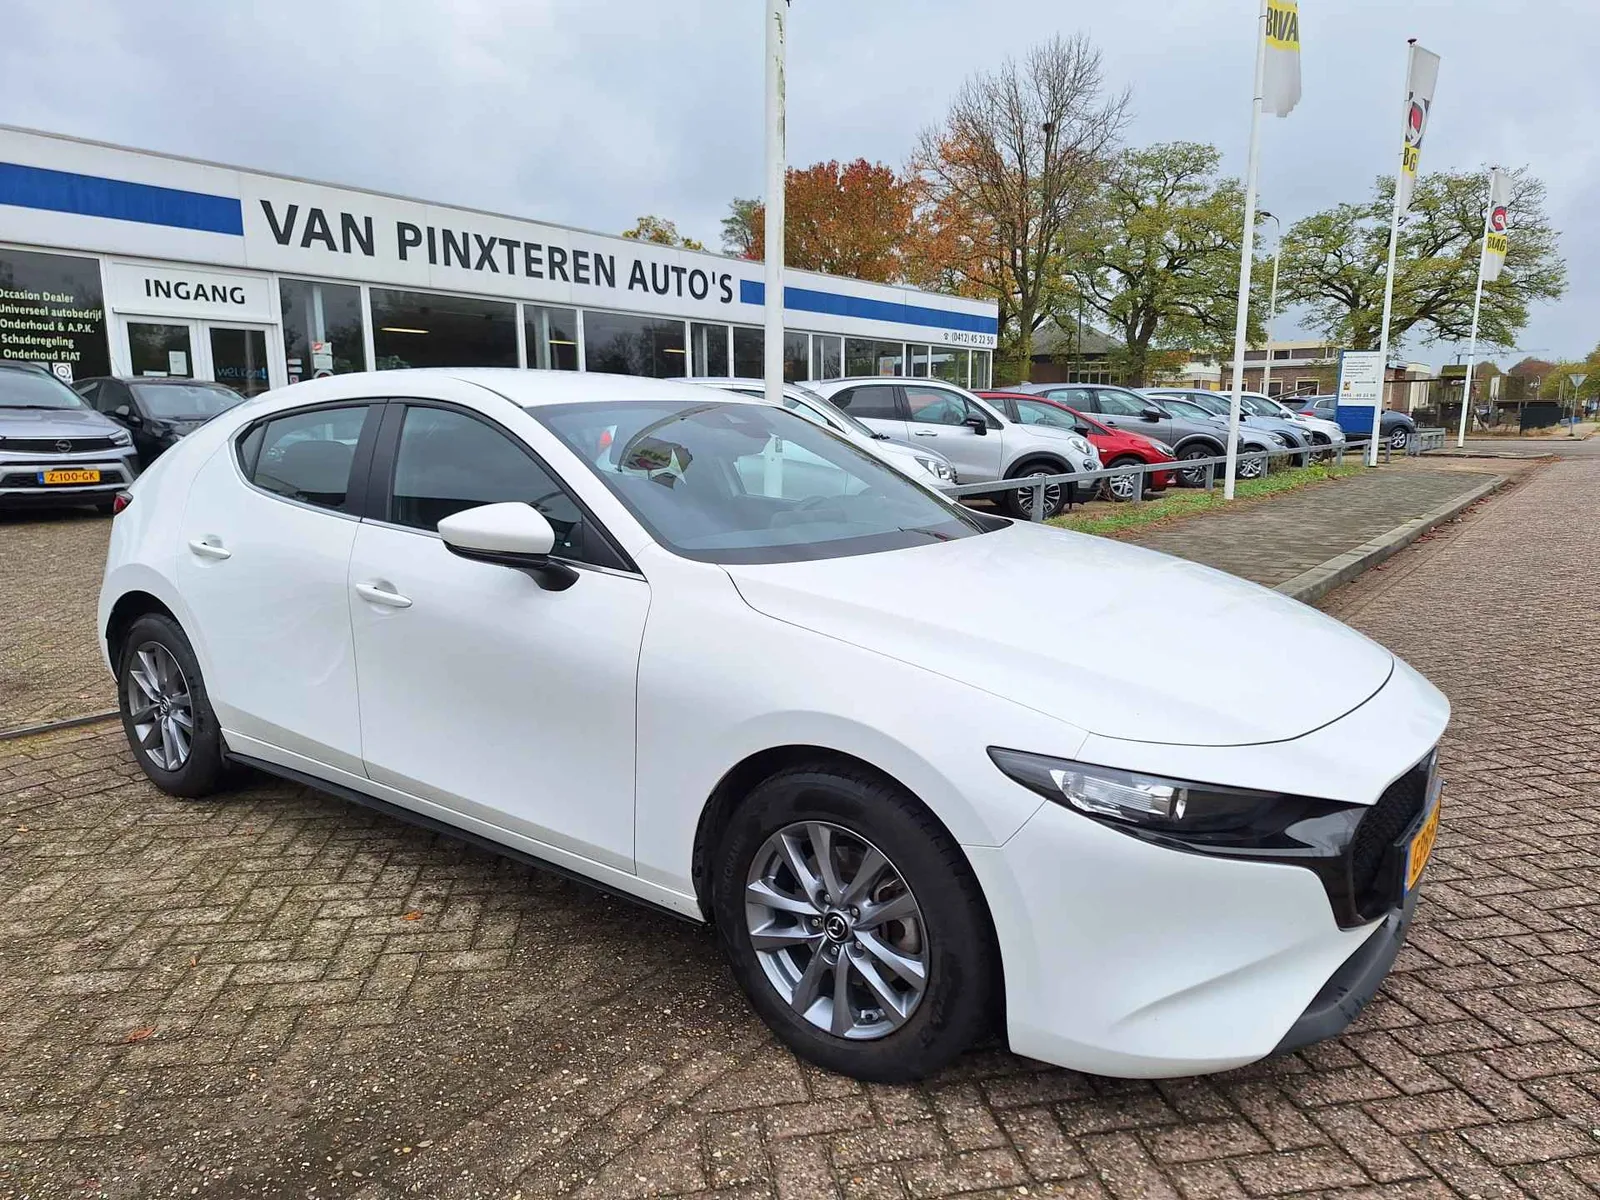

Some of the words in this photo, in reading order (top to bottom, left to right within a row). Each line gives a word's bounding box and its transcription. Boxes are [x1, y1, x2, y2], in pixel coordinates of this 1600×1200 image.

[259, 199, 375, 257] VAN
[397, 221, 616, 288] PINXTEREN
[628, 260, 733, 304] AUTO'S
[43, 291, 74, 303] Dealer
[145, 279, 246, 305] INGANG
[0, 303, 48, 315] Universeel
[51, 309, 102, 322] autobedrijf
[0, 320, 55, 331] Onderhoud
[57, 322, 65, 332] &
[67, 323, 95, 333] A.P.K.
[1, 334, 74, 349] Schaderegeling
[951, 332, 970, 343] (0412)
[971, 335, 977, 343] 45
[979, 335, 985, 343] 22
[3, 349, 58, 361] Onderhoud
[61, 351, 81, 361] FIAT
[49, 471, 96, 482] Z-100-GK
